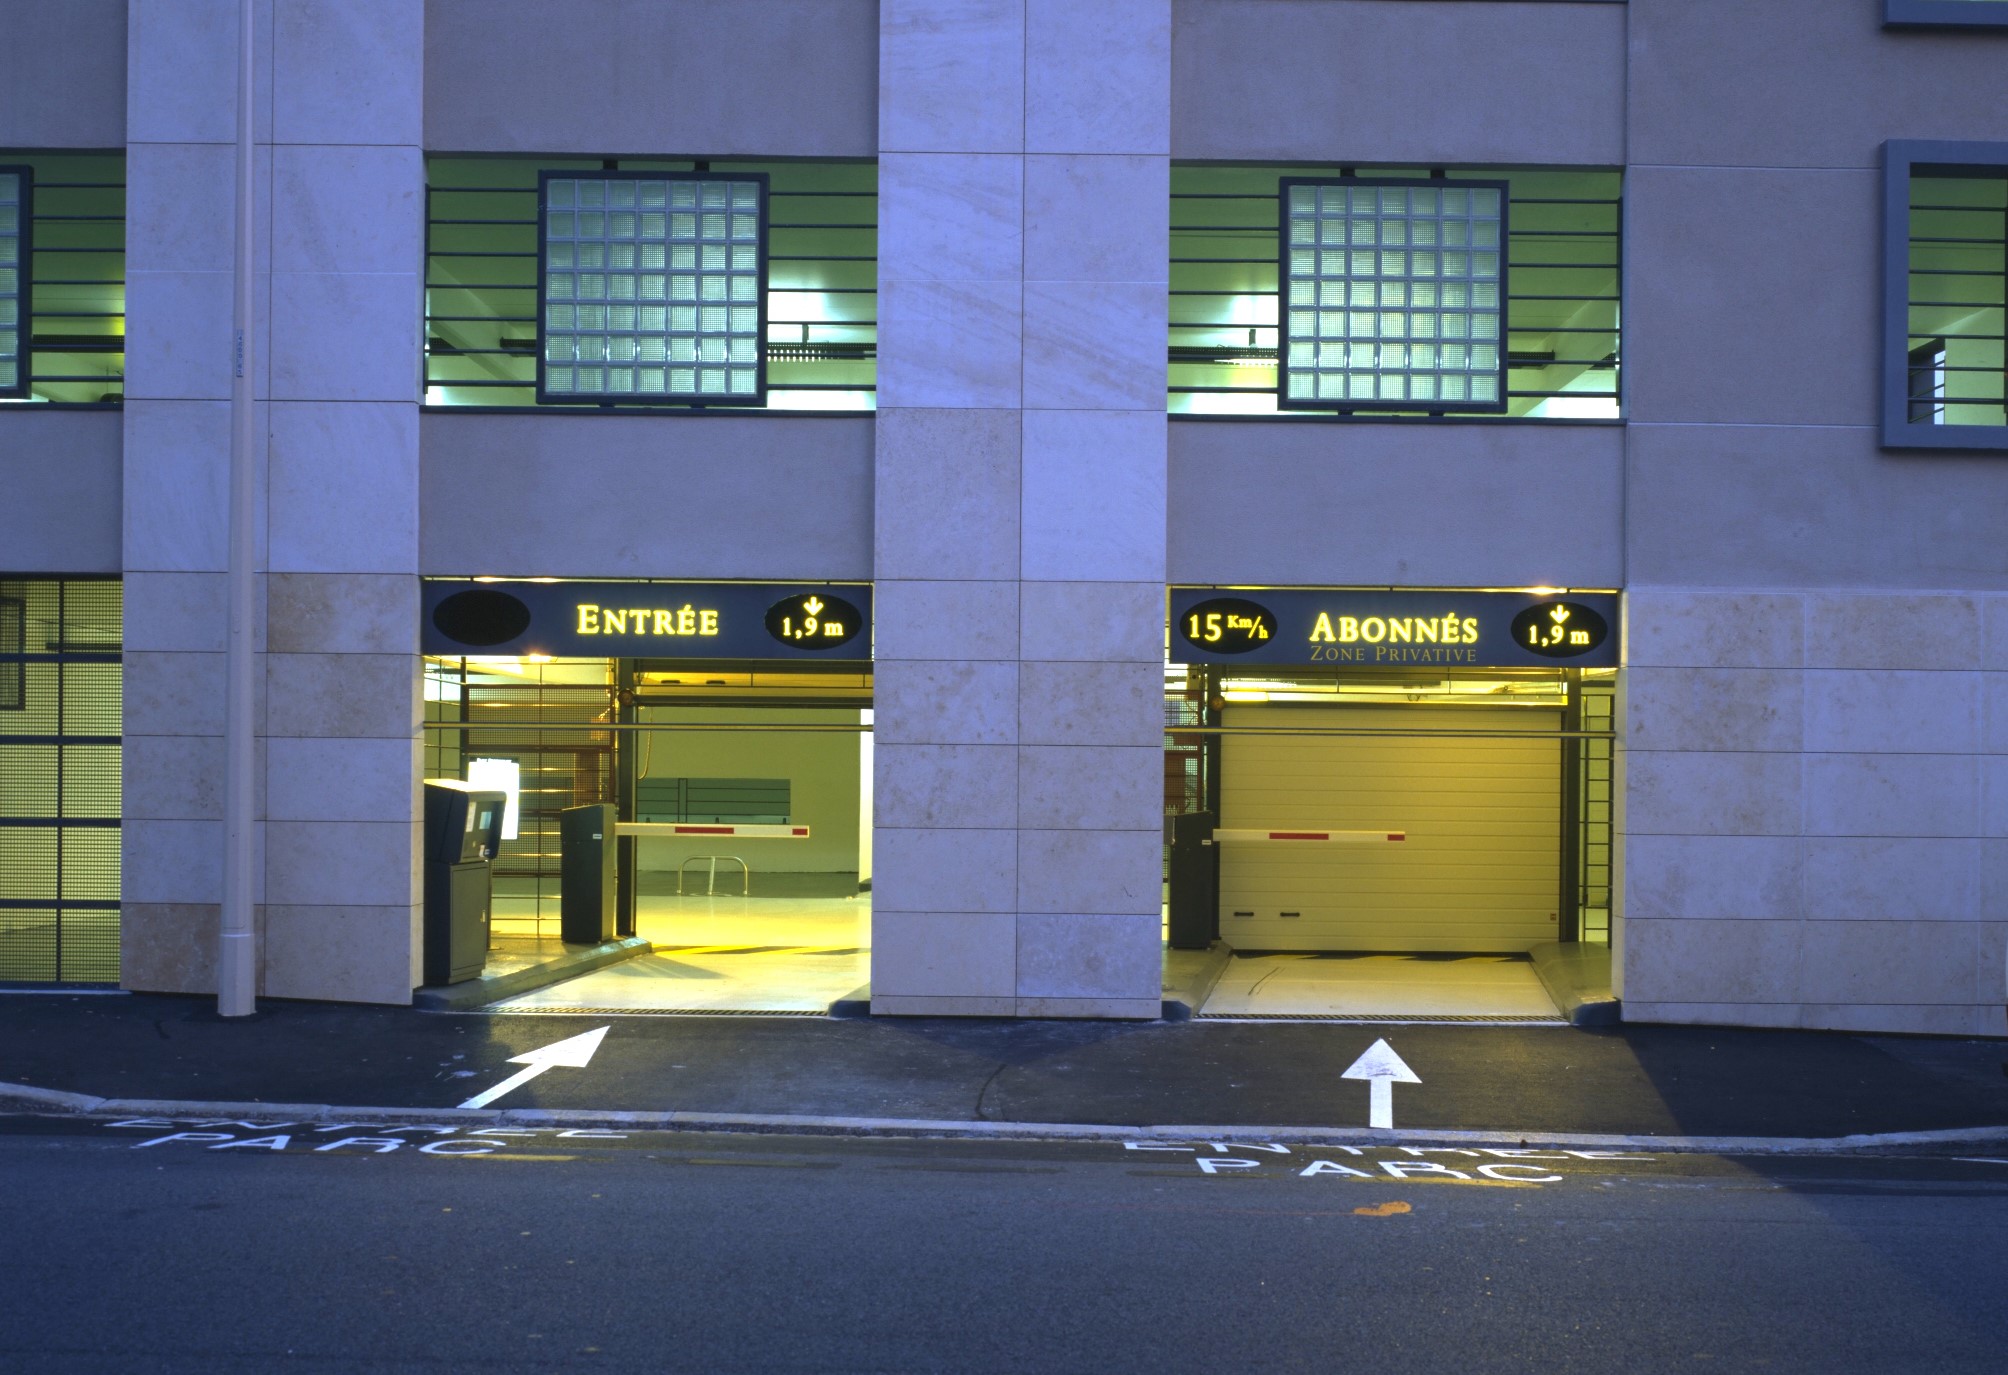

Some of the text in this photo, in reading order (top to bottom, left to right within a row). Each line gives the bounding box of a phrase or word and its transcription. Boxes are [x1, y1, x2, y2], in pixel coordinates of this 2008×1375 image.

[576, 604, 719, 636] ENTRÉE
[782, 617, 844, 640] 1,9 m
[1189, 613, 1269, 642] 15 Km/h
[1309, 612, 1478, 643] ABONNÉS
[1529, 624, 1590, 647] 1,9 m
[1310, 645, 1477, 662] ZONE PRIVATIVE
[130, 1132, 507, 1155] PARC
[1196, 1157, 1563, 1182] PARC
